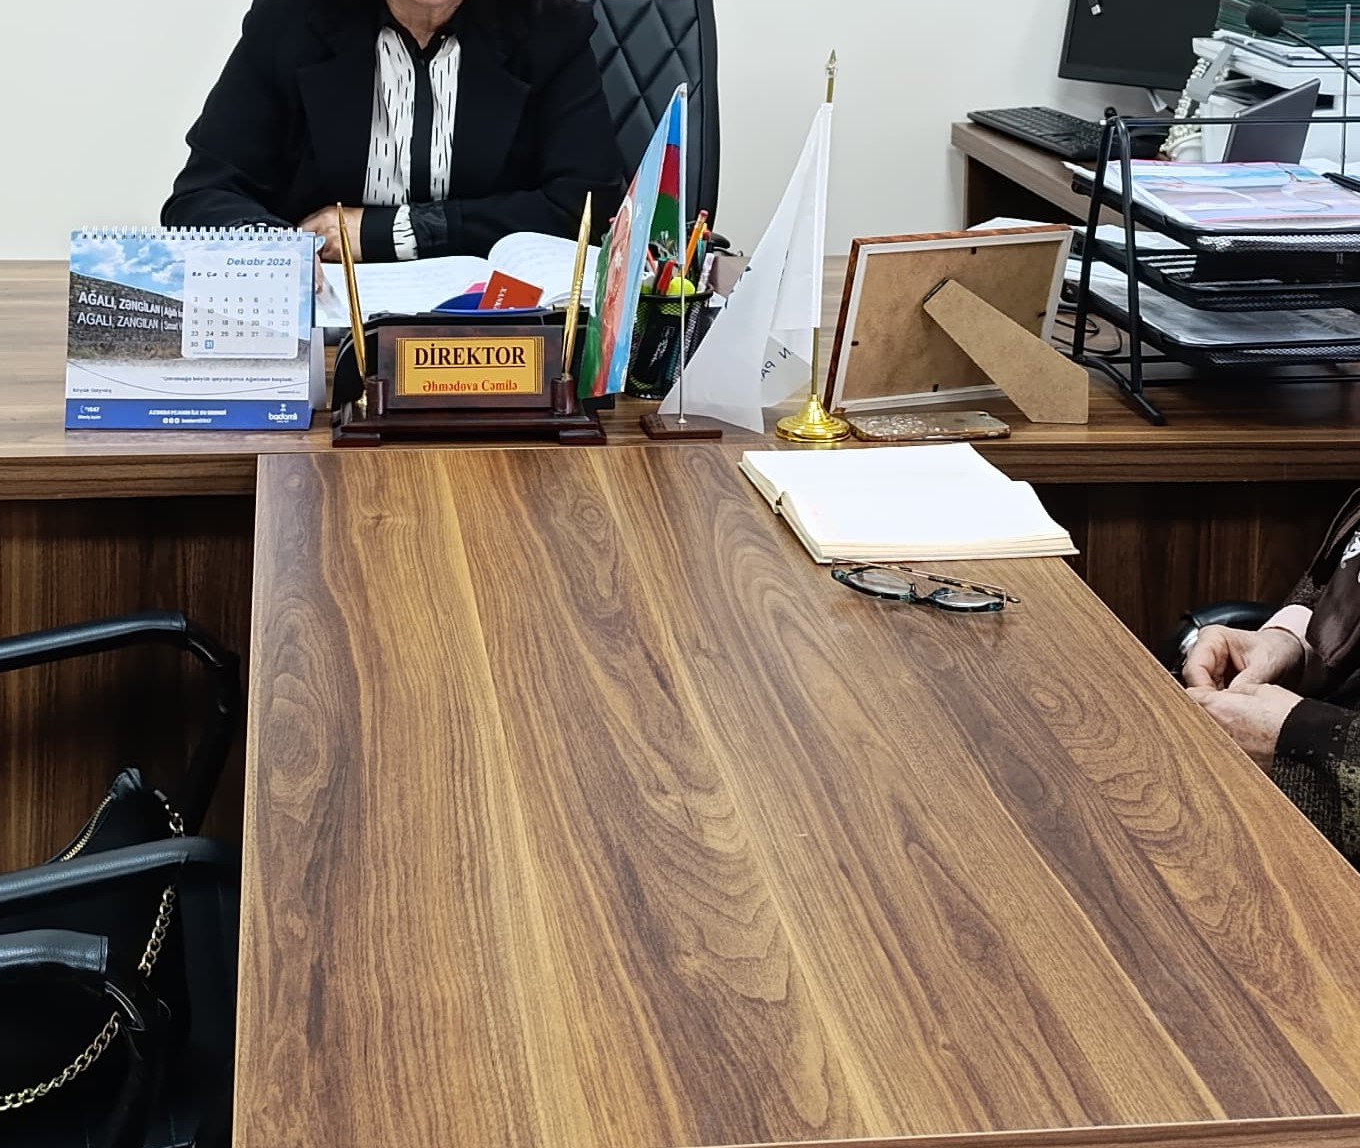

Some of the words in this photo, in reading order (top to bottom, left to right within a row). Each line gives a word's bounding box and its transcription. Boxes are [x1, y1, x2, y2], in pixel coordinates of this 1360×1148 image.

[226, 257, 265, 266] Dekabr
[266, 258, 292, 266] 2024
[414, 343, 526, 366] DİREKTOR
[422, 380, 478, 392] Əhmədova
[481, 380, 518, 392] Cəmilə
